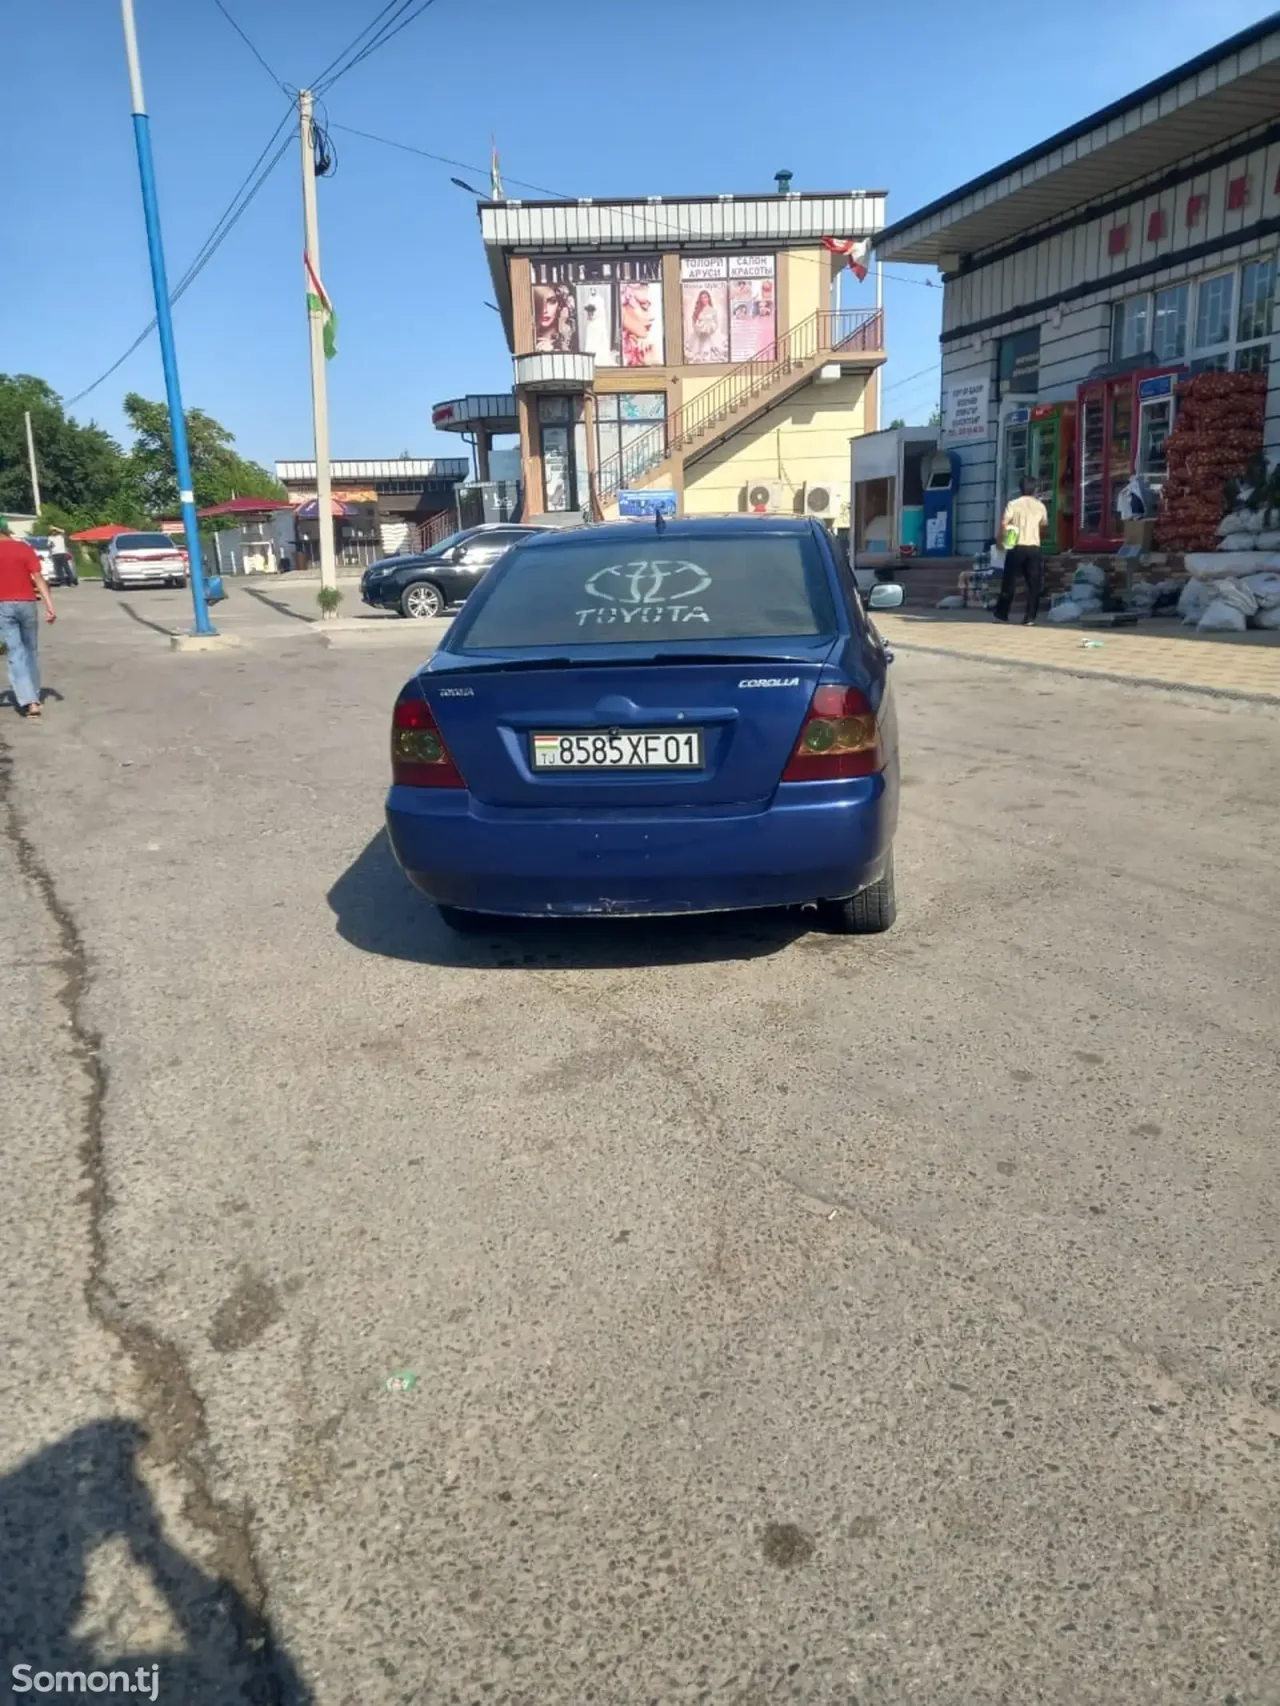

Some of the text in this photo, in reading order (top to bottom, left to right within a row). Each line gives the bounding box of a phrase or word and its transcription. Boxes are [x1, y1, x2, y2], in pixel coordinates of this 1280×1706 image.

[737, 256, 767, 265] САЛОН
[731, 266, 773, 276] КРАСОТЫ
[575, 605, 711, 626] TOYOTA
[738, 677, 799, 688] COROLLA
[541, 735, 694, 764] TJ 8585XF01
